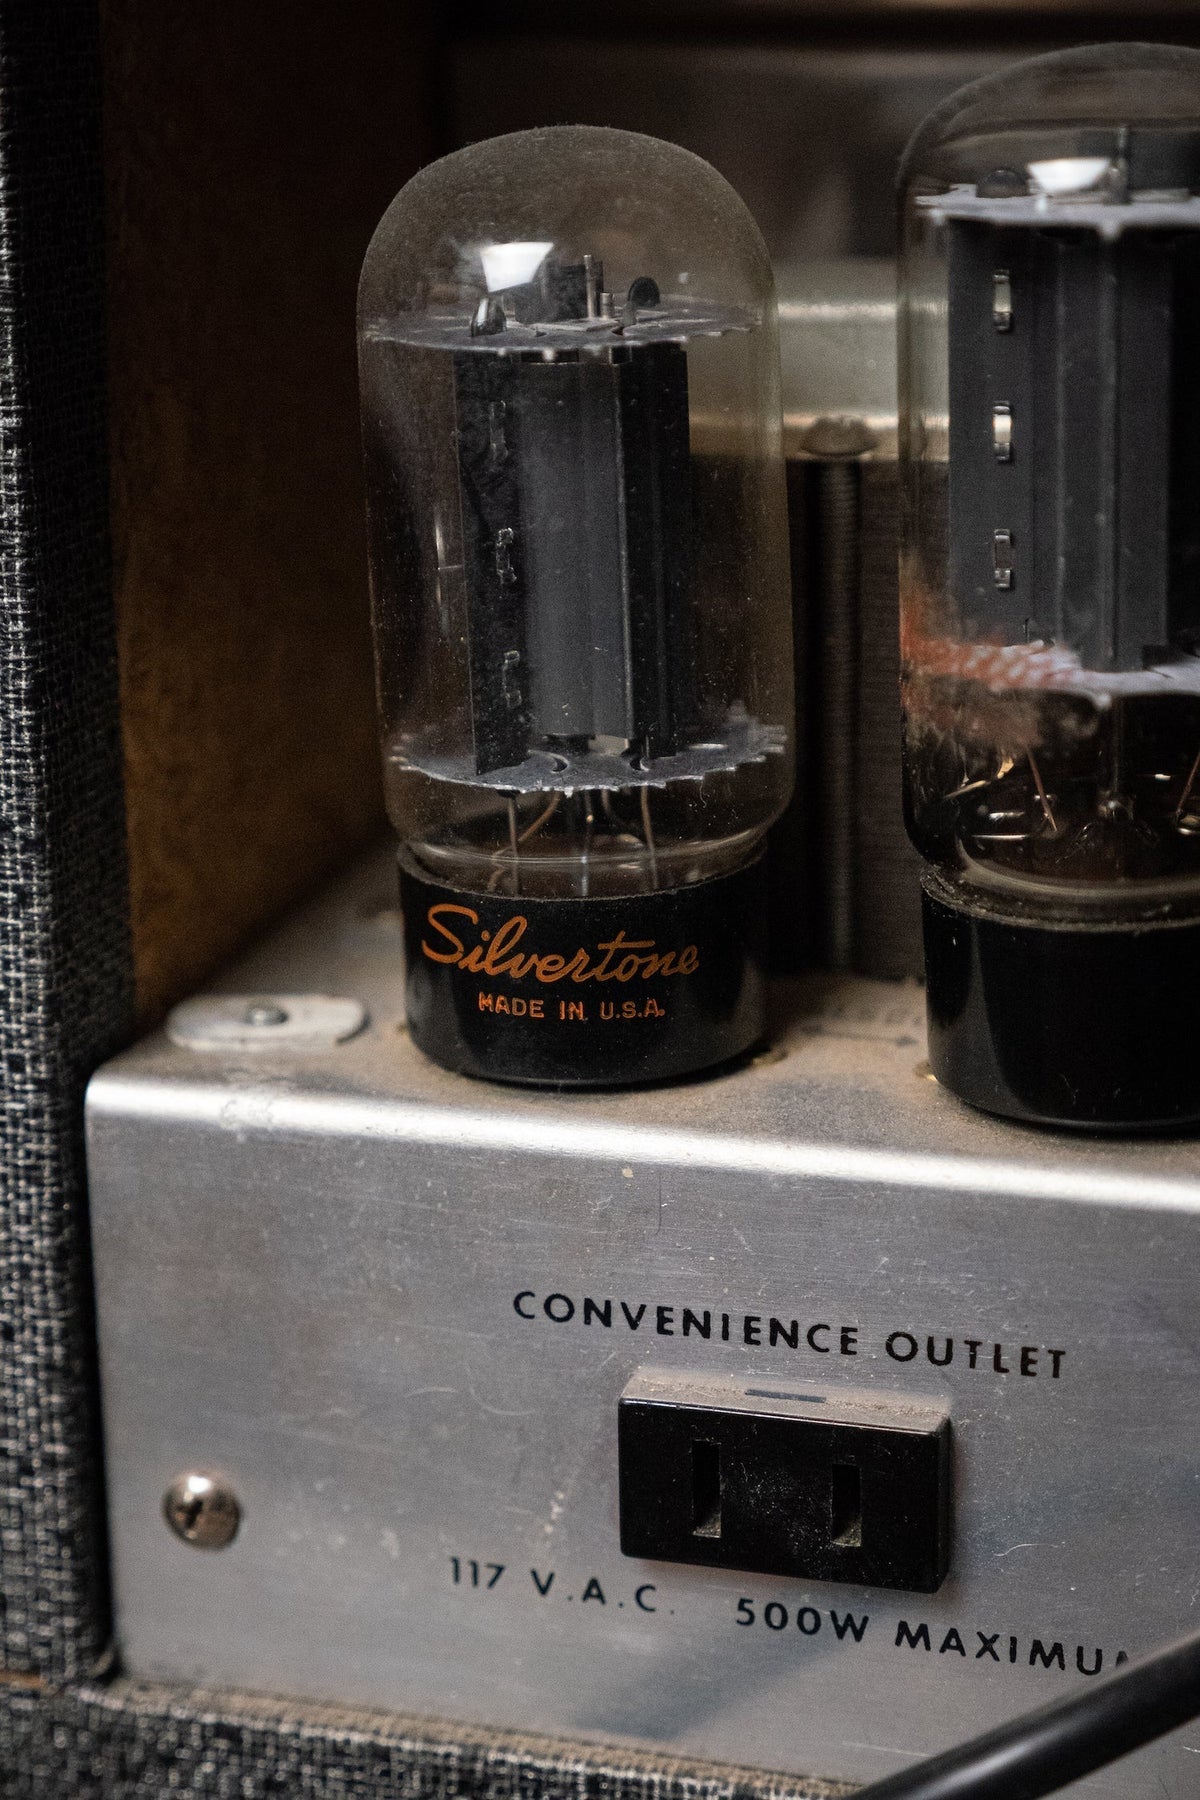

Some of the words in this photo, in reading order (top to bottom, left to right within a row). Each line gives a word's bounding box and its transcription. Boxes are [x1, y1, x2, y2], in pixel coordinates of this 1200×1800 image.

[421, 903, 700, 983] Silvertone
[478, 991, 545, 1018] MADE
[559, 1000, 585, 1020] IN
[600, 998, 666, 1020] U.S.A.
[513, 1290, 858, 1355] CONVENIENCE
[885, 1330, 1067, 1378] OUTLET
[451, 1556, 506, 1589] 117
[736, 1597, 869, 1643] 500W
